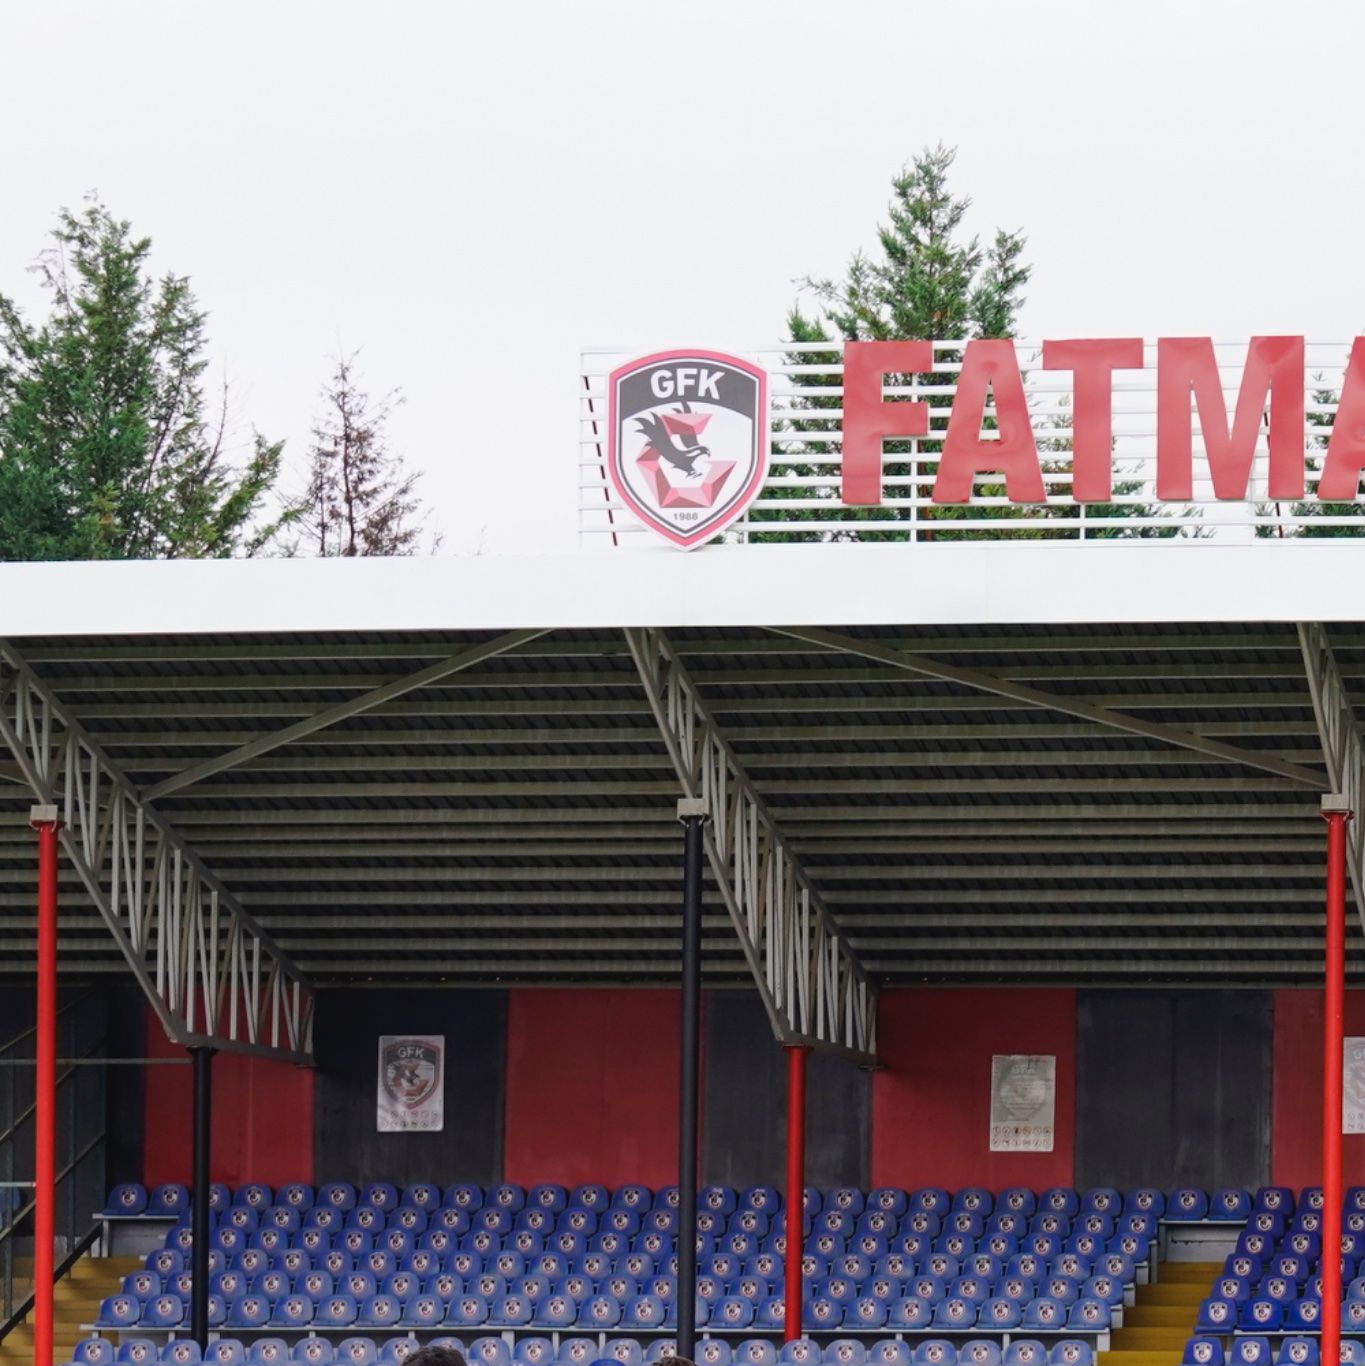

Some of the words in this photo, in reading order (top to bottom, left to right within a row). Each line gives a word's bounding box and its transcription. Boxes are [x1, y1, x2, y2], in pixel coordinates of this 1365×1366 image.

[650, 367, 725, 400] GFK
[673, 512, 699, 521] 1988
[398, 1047, 425, 1058] GFK
